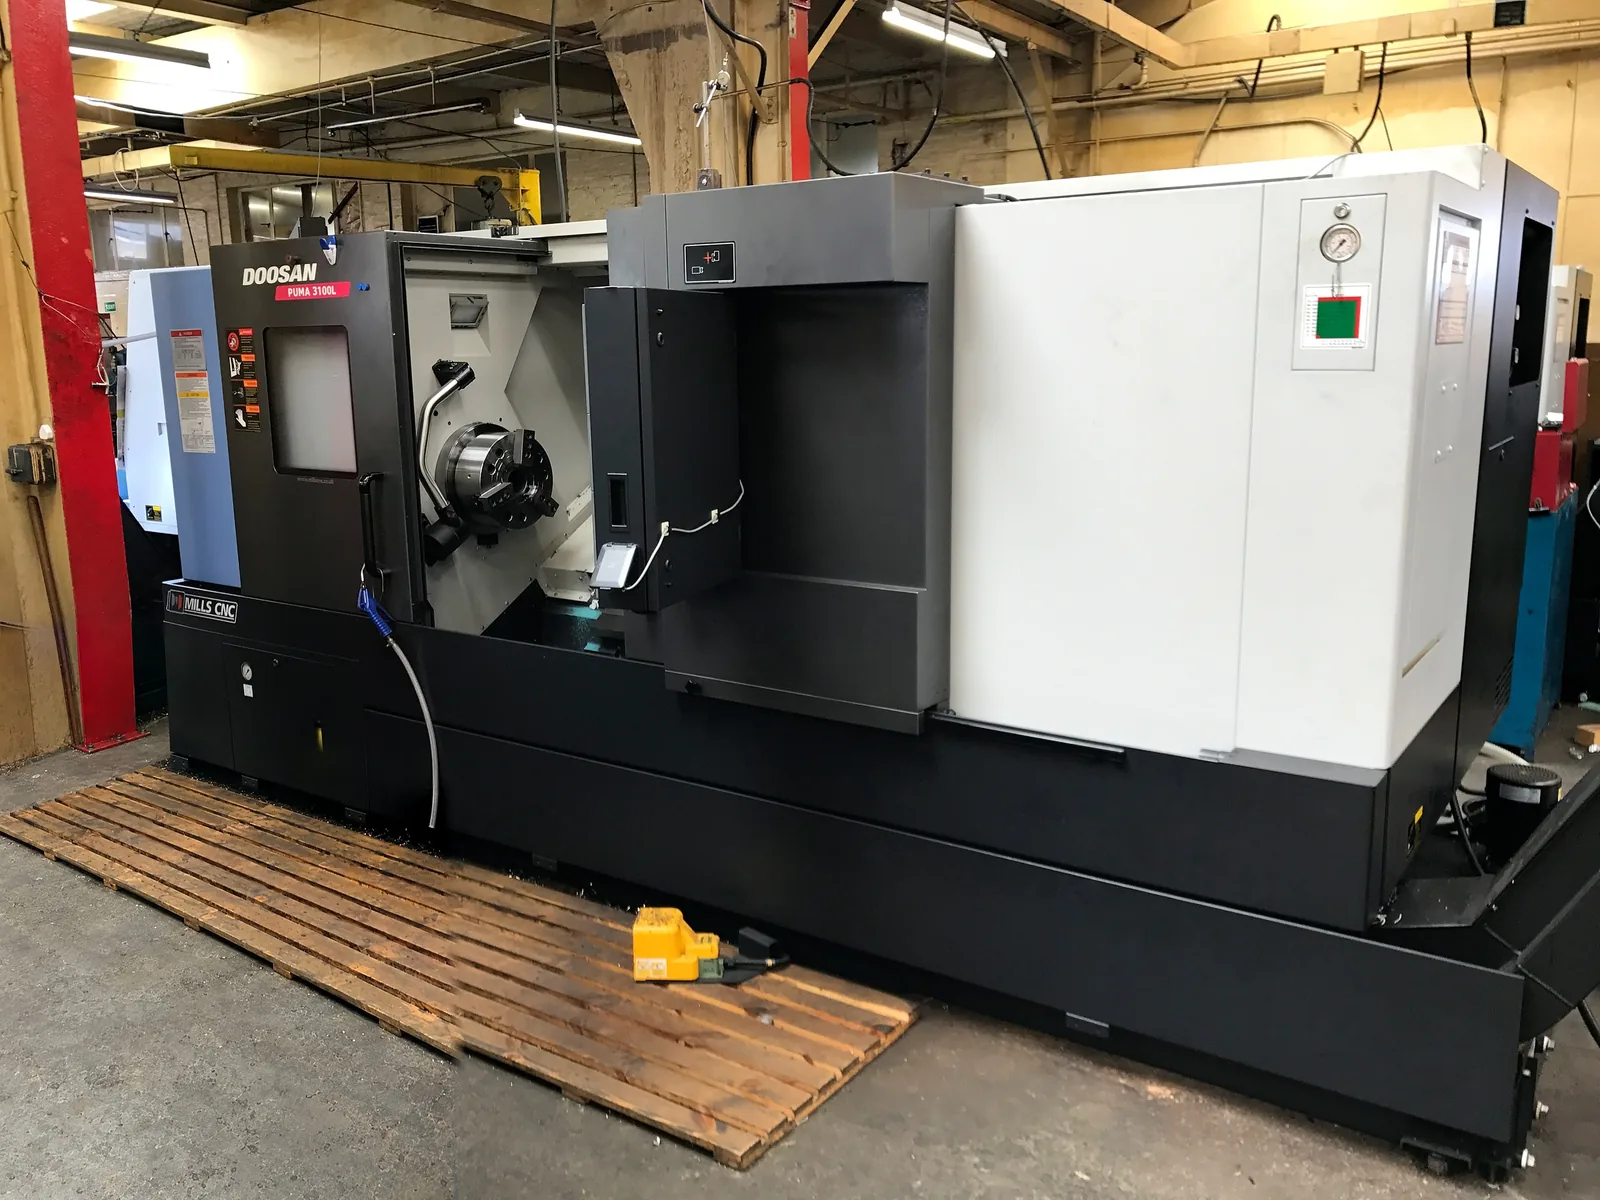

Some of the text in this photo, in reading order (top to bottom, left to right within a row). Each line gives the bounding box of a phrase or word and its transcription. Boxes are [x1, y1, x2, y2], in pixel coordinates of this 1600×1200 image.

[242, 263, 318, 285] DOOSAN
[287, 285, 336, 297] PUMA 3100L
[184, 597, 236, 618] MILLS CNC
